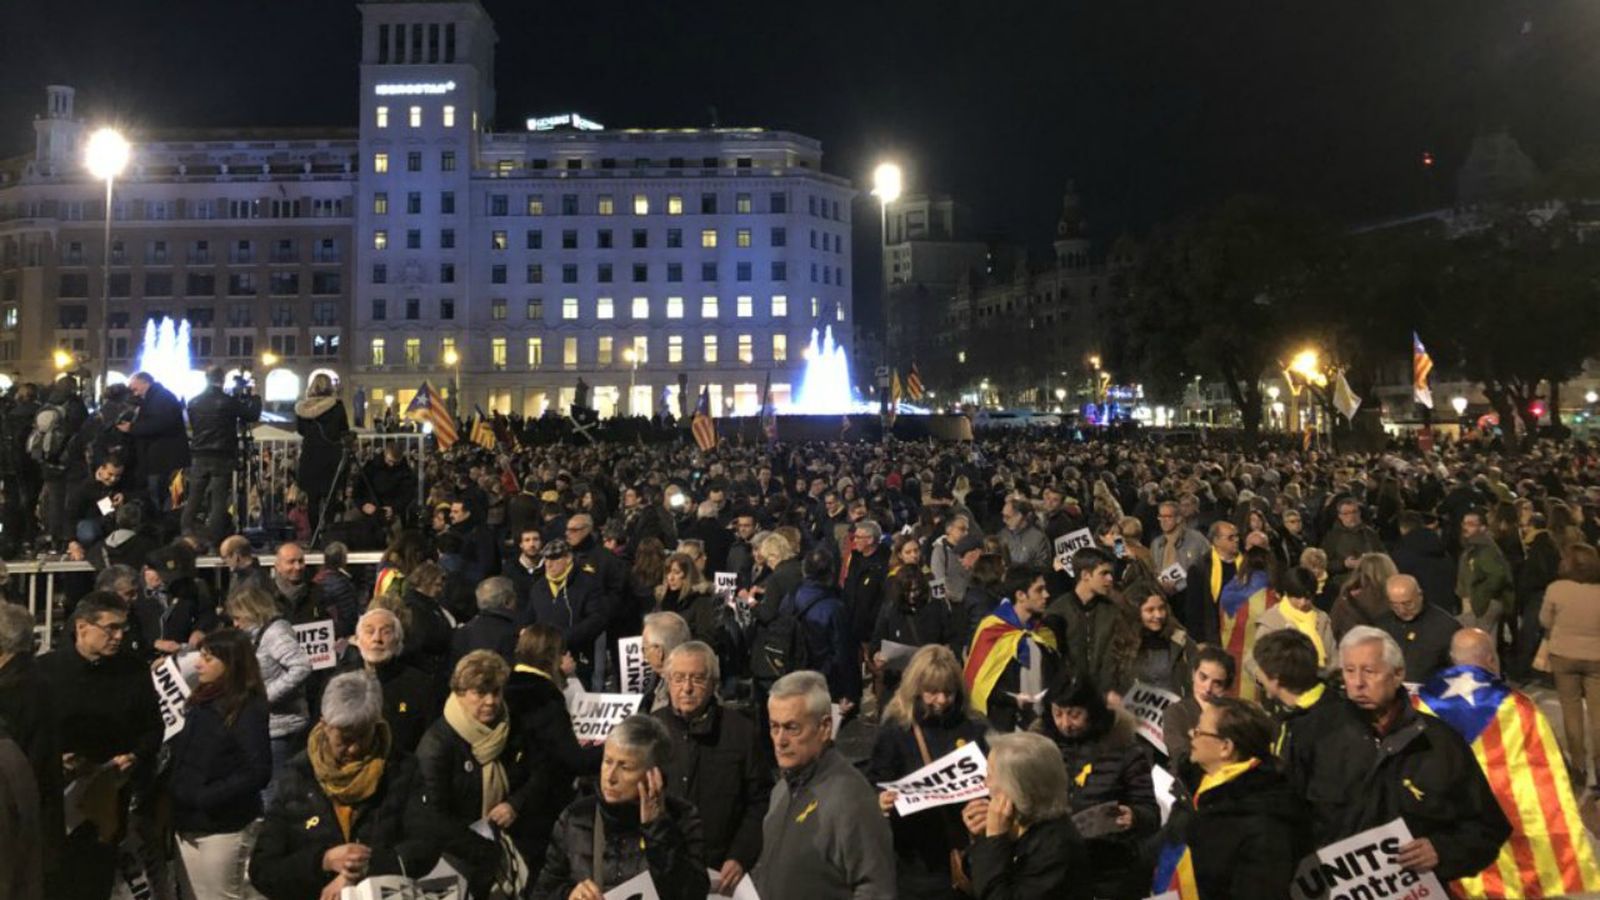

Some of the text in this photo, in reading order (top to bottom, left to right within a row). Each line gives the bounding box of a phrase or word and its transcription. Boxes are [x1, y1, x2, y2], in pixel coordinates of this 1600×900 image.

[1056, 534, 1092, 554] UNITS
[1132, 689, 1170, 711] UNI
[1297, 837, 1400, 899] UNITS
